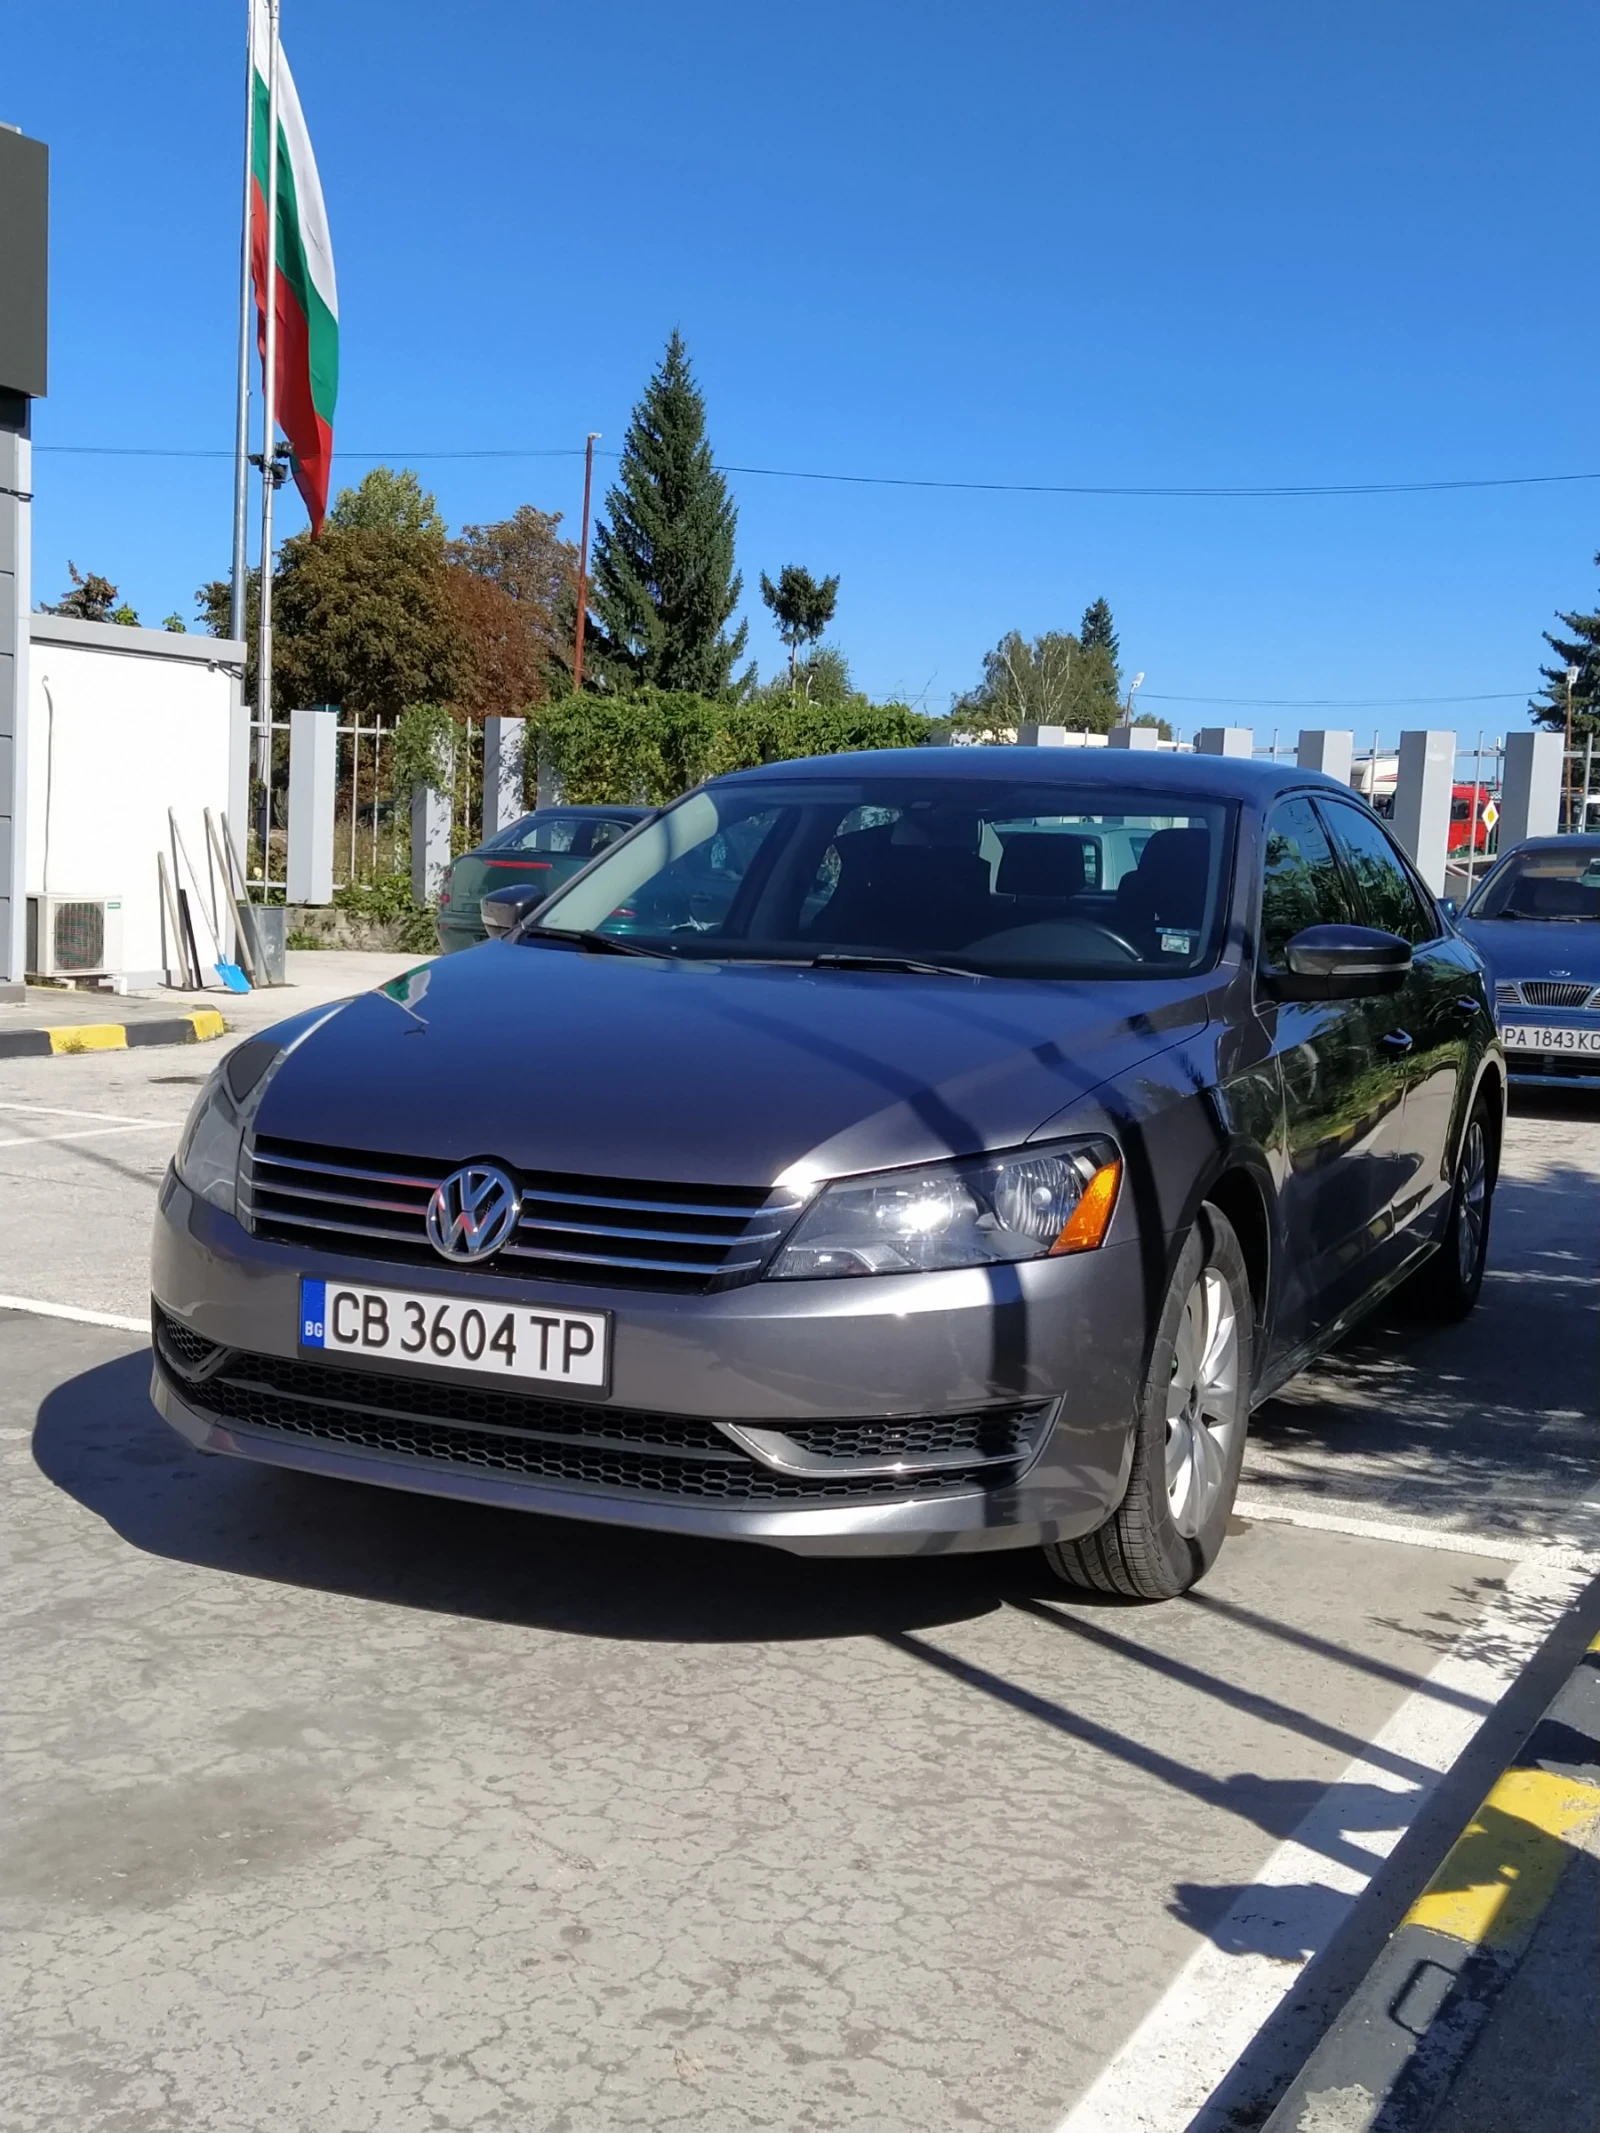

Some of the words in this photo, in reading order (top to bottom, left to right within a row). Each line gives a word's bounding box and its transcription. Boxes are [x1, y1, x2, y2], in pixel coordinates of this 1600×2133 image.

[1504, 1028, 1527, 1045] PA
[1534, 1030, 1574, 1048] 1843
[428, 1166, 516, 1261] VW
[305, 1321, 323, 1337] BG
[332, 1291, 390, 1348] CB
[400, 1301, 516, 1366] 3604
[530, 1315, 594, 1374] TP
